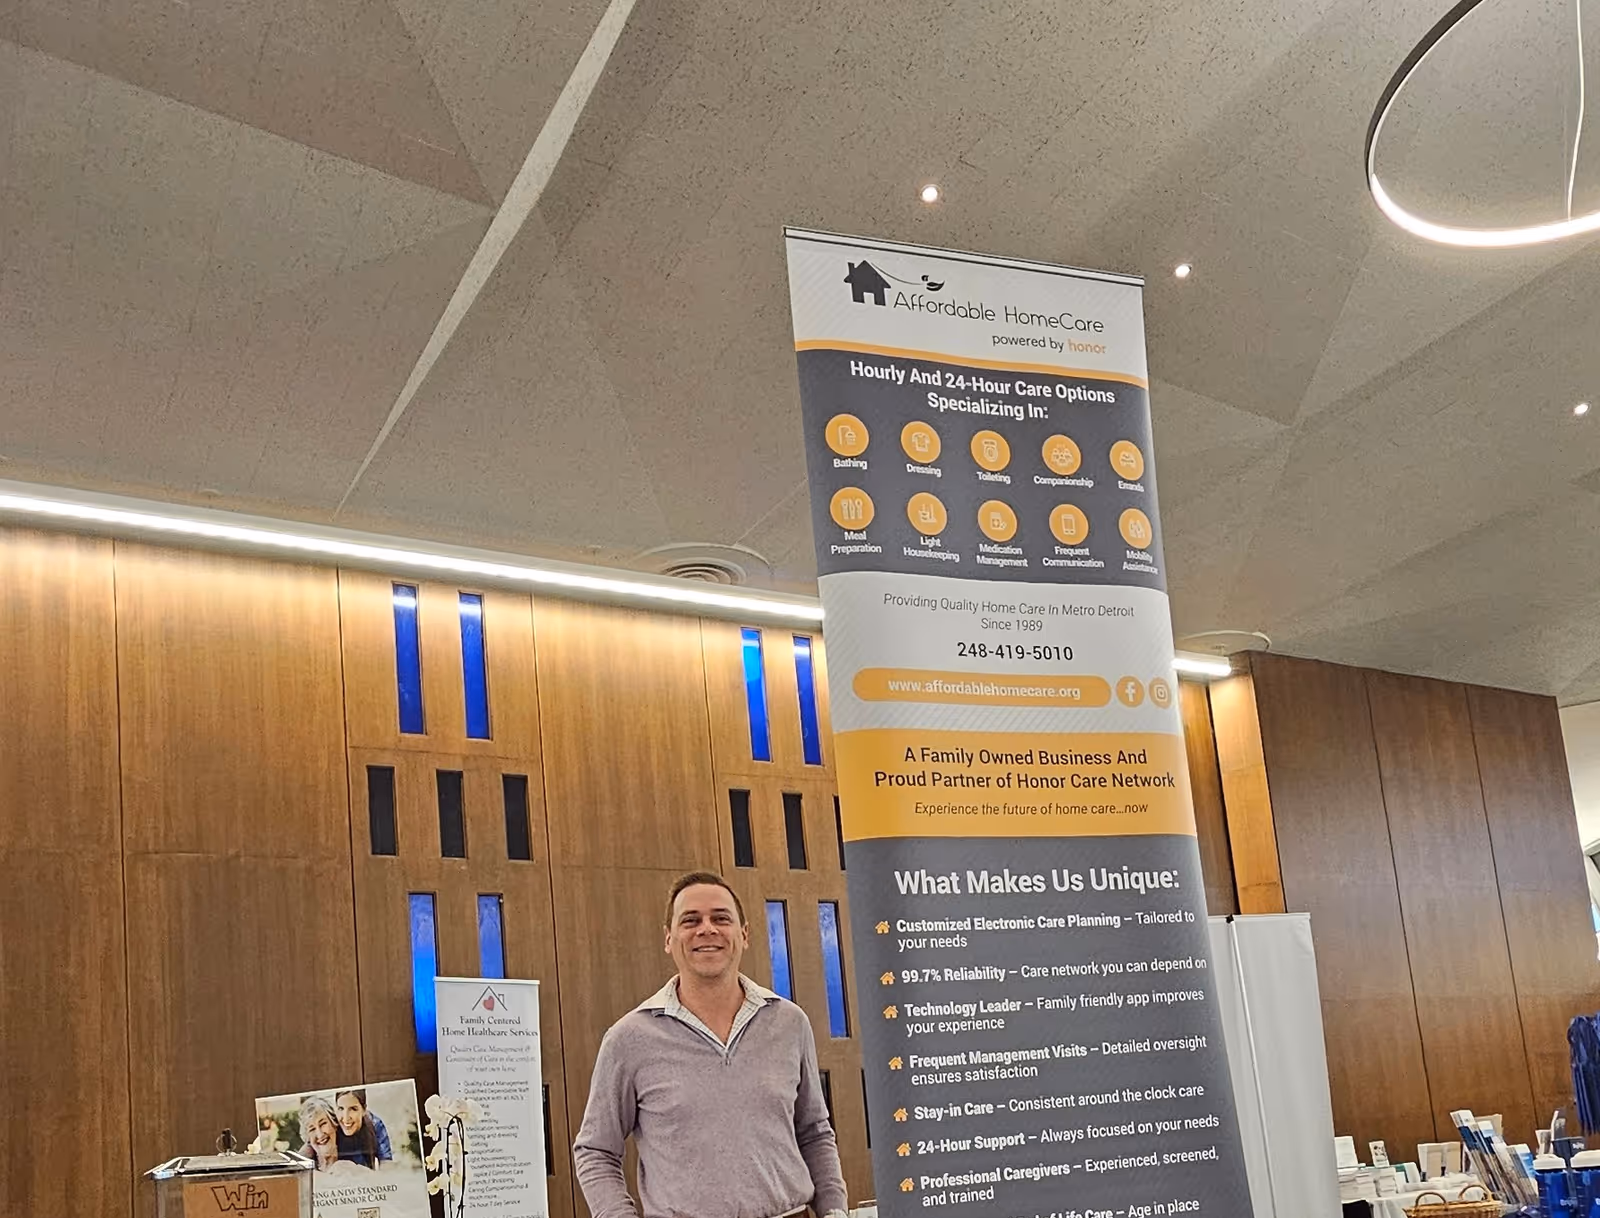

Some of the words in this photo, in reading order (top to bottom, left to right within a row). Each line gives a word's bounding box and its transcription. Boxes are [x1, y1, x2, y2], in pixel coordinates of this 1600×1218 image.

[893, 292, 996, 322] Affordable
[1005, 306, 1104, 333] HomeCare
[992, 334, 1046, 350] powered
[1050, 337, 1064, 352] by
[1068, 339, 1106, 354] honor
[850, 360, 905, 384] Hourly
[910, 368, 941, 387] And
[945, 372, 1011, 394] 24-Hour
[1014, 380, 1051, 398] Care
[1055, 384, 1115, 403] Options
[928, 392, 1024, 420] Specializing
[1028, 404, 1049, 419] In:
[834, 458, 867, 470] Bathing
[906, 463, 941, 477] Dressing
[976, 472, 1011, 484] Toileting
[1034, 475, 1094, 488] Companionship
[844, 531, 866, 540] Meal
[920, 536, 941, 547] Light
[830, 544, 882, 554] Preparation
[903, 547, 960, 562] Housekeeping
[979, 543, 1022, 555] Medication
[1054, 546, 1090, 556] Frequent
[1126, 550, 1153, 563] Mobility
[976, 555, 1028, 568] Management
[1042, 557, 1104, 568] Communication
[1122, 561, 1158, 574] Assistance
[884, 593, 937, 611] Providing
[940, 598, 978, 615] Quality
[982, 600, 1016, 614] Home
[1019, 602, 1046, 615] Care
[1048, 603, 1060, 616] In
[1062, 604, 1096, 616] Metro
[1098, 604, 1134, 617] Detroit
[981, 618, 1012, 631] Since
[1015, 618, 1043, 632] 1989
[957, 642, 1073, 662] 248-419-5010
[888, 678, 1080, 700] www.affordablehomecare.org
[904, 746, 916, 763] A
[922, 746, 973, 768] Family
[980, 748, 1034, 766] Owned
[1039, 750, 1111, 766] Business
[1117, 749, 1147, 765] And
[875, 771, 926, 788] Proud
[932, 772, 992, 788] Partner
[996, 772, 1012, 788] of
[1017, 772, 1066, 789] Honor
[1070, 772, 1107, 788] Care
[1112, 772, 1174, 788] Network
[914, 802, 978, 818] Experience
[981, 802, 1000, 815] the
[1003, 802, 1038, 816] future
[1041, 802, 1053, 815] of
[1055, 802, 1088, 815] home
[1090, 802, 1148, 814] care...now
[895, 870, 960, 894] What
[967, 870, 1046, 894] Makes
[1052, 868, 1084, 892] Us
[1090, 865, 1180, 894] Unique:
[896, 917, 972, 933] Customized
[974, 916, 1035, 931] Electronic
[1038, 916, 1065, 930] Care
[1068, 914, 1121, 930] Planning
[1135, 910, 1182, 925] Tailored
[1184, 912, 1195, 922] to
[898, 937, 927, 952] your
[930, 934, 967, 948] needs
[901, 969, 942, 984] 99.7%
[944, 966, 1006, 982] Reliability
[1020, 964, 1048, 978] Care
[1051, 962, 1098, 976] network
[1102, 963, 1123, 976] you
[1126, 961, 1148, 972] can
[1150, 958, 1192, 974] depend
[1195, 958, 1207, 969] on
[904, 1001, 977, 1020] Technology
[980, 999, 1022, 1014] Leader
[1036, 996, 1078, 1013] Family
[1080, 993, 1124, 1010] friendly
[1126, 993, 1150, 1006] app
[1152, 988, 1204, 1005] improves
[460, 1016, 484, 1025] Family
[488, 1016, 520, 1024] Centered
[906, 1022, 934, 1037] your
[938, 1016, 1005, 1034] experience
[442, 1027, 465, 1036] Home
[468, 1027, 508, 1036] Healthcare
[909, 1053, 966, 1070] Frequent
[970, 1048, 1050, 1067] Management
[1052, 1044, 1087, 1060] Visits
[1102, 1039, 1150, 1055] Detailed
[1154, 1036, 1206, 1052] oversight
[911, 1070, 962, 1086] ensures
[965, 1064, 1038, 1082] satisfaction
[914, 1104, 962, 1122] Stay-in
[965, 1103, 994, 1116] Care
[1009, 1095, 1076, 1112] Consistent
[1078, 1090, 1120, 1106] around
[1122, 1089, 1142, 1103] the
[1144, 1086, 1176, 1100] clock
[1179, 1085, 1204, 1098] care
[918, 1137, 972, 1154] 24-Hour
[974, 1132, 1025, 1152] Support
[1040, 1127, 1084, 1146] Always
[1087, 1121, 1136, 1138] focused
[1138, 1122, 1153, 1134] on
[1155, 1118, 1182, 1134] your
[1184, 1114, 1220, 1129] needs
[920, 1168, 1001, 1190] Professional
[1004, 1162, 1070, 1182] Caregivers
[1085, 1153, 1161, 1172] Experienced,
[1163, 1146, 1219, 1164] screened,
[210, 1183, 269, 1212] Win
[331, 1190, 336, 1198] A
[337, 1188, 356, 1198] NEW
[358, 1184, 398, 1195] STANDARD
[340, 1195, 368, 1206] SENIOR
[368, 1193, 388, 1203] CARE
[922, 1191, 947, 1207] and
[950, 1186, 994, 1204] trained
[1154, 1202, 1166, 1216] in
[1168, 1198, 1200, 1216] place
